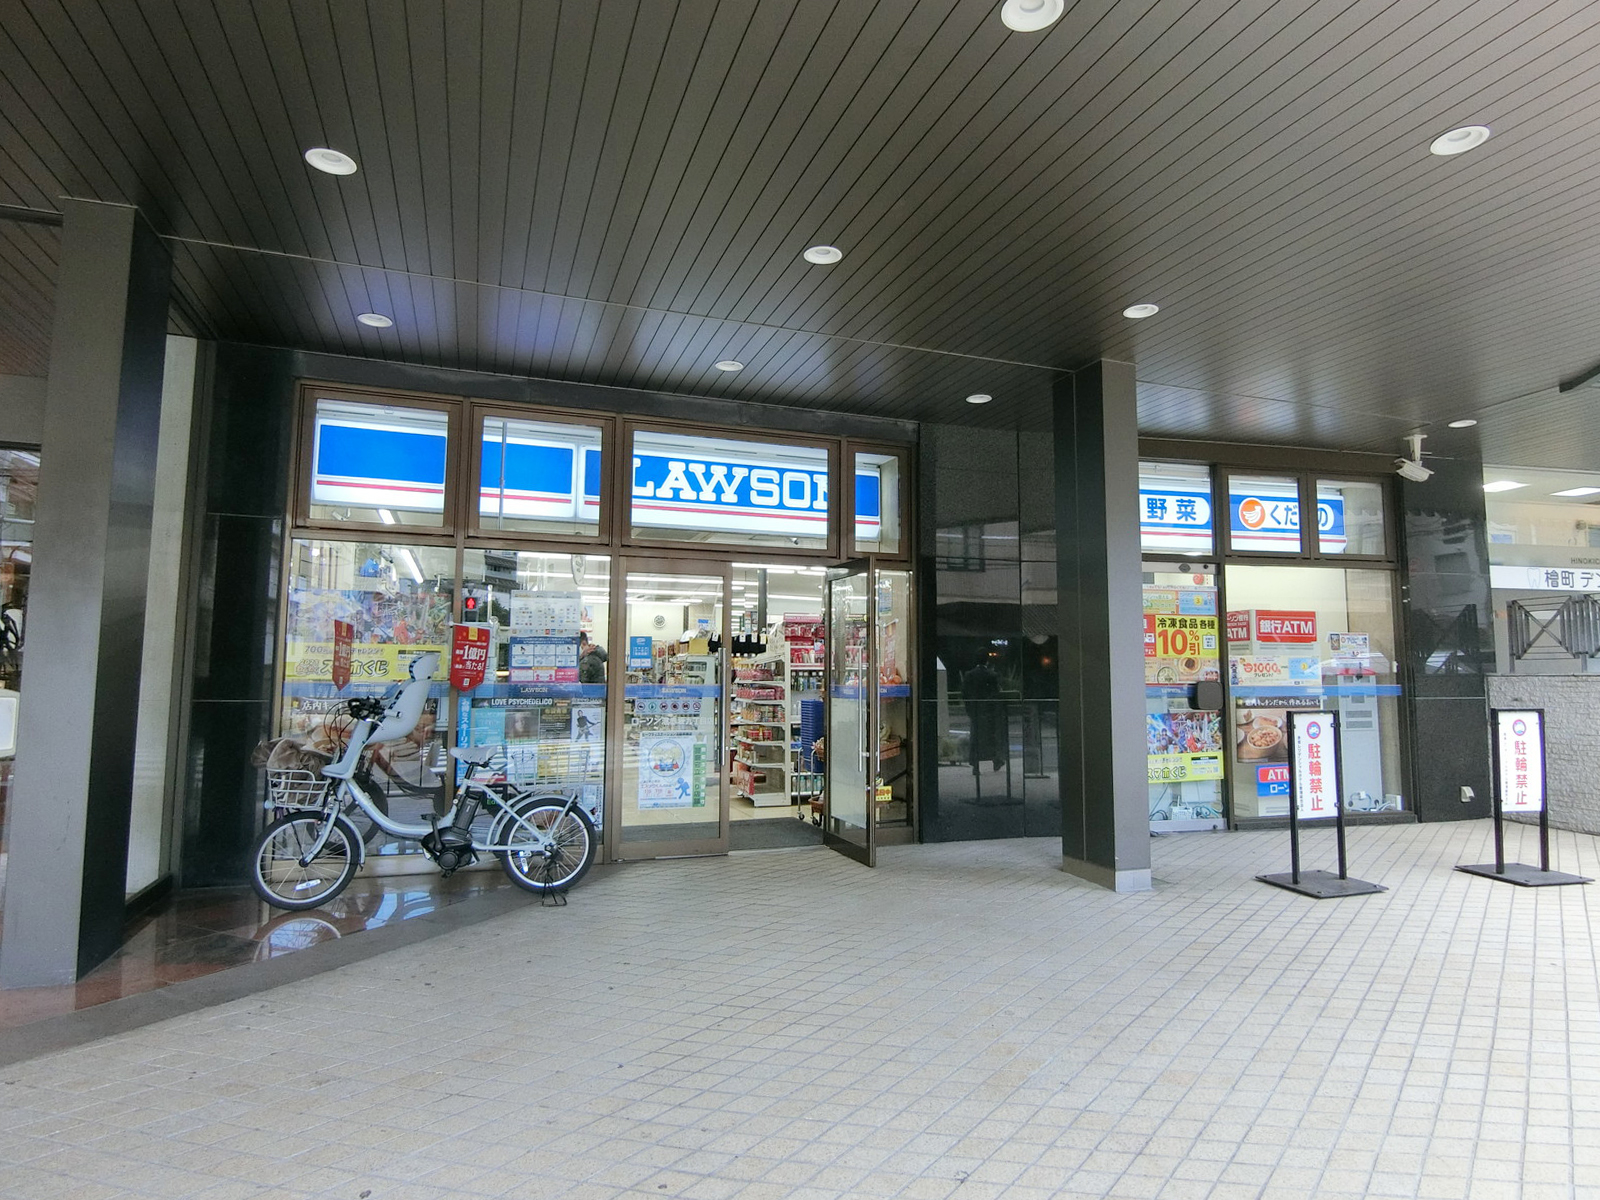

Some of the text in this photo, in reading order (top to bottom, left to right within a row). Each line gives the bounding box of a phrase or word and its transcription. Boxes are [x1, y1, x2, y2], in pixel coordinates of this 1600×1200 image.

[1146, 497, 1197, 522] 野菜
[1157, 617, 1199, 630] 冷凍食品
[1199, 619, 1215, 630] 各種
[1259, 619, 1313, 634] 銀行ATM
[1227, 627, 1247, 639] ATM
[319, 658, 389, 677] スホくじ
[491, 698, 553, 706] LOVE PSYCHEDELICO
[1307, 742, 1324, 812] 駐輪禁止
[1514, 740, 1528, 805] 駐輪禁止
